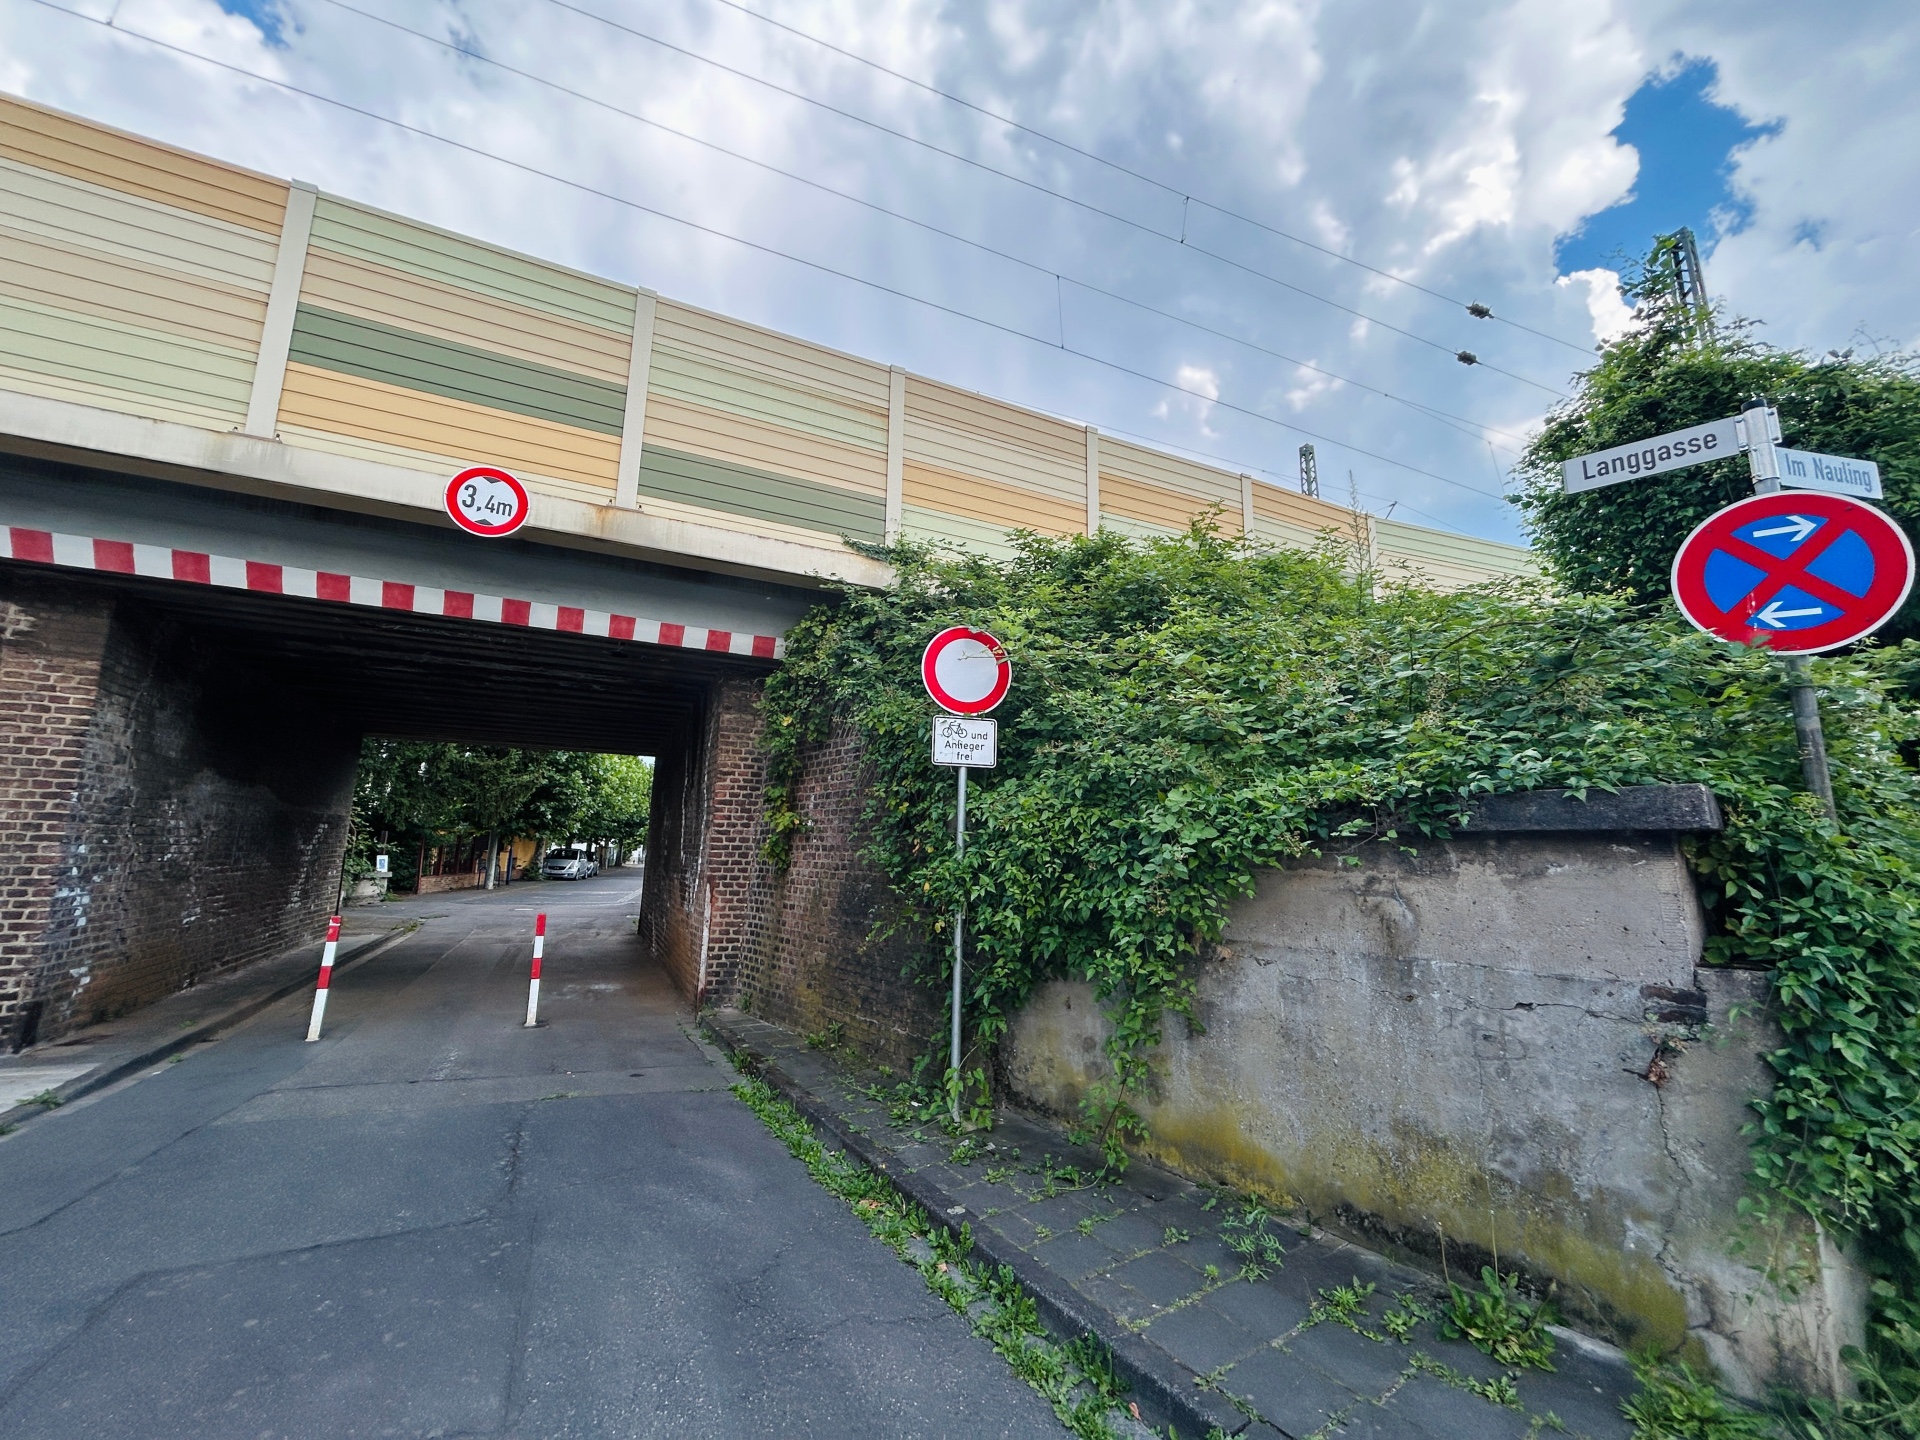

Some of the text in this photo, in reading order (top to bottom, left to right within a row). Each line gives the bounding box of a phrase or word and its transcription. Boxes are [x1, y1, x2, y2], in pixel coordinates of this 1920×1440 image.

[1582, 432, 1718, 481] Langgasse
[1785, 453, 1873, 492] Im Nauling
[462, 484, 513, 517] 3,4m
[944, 740, 984, 752] Anlieger
[956, 752, 972, 760] frei
